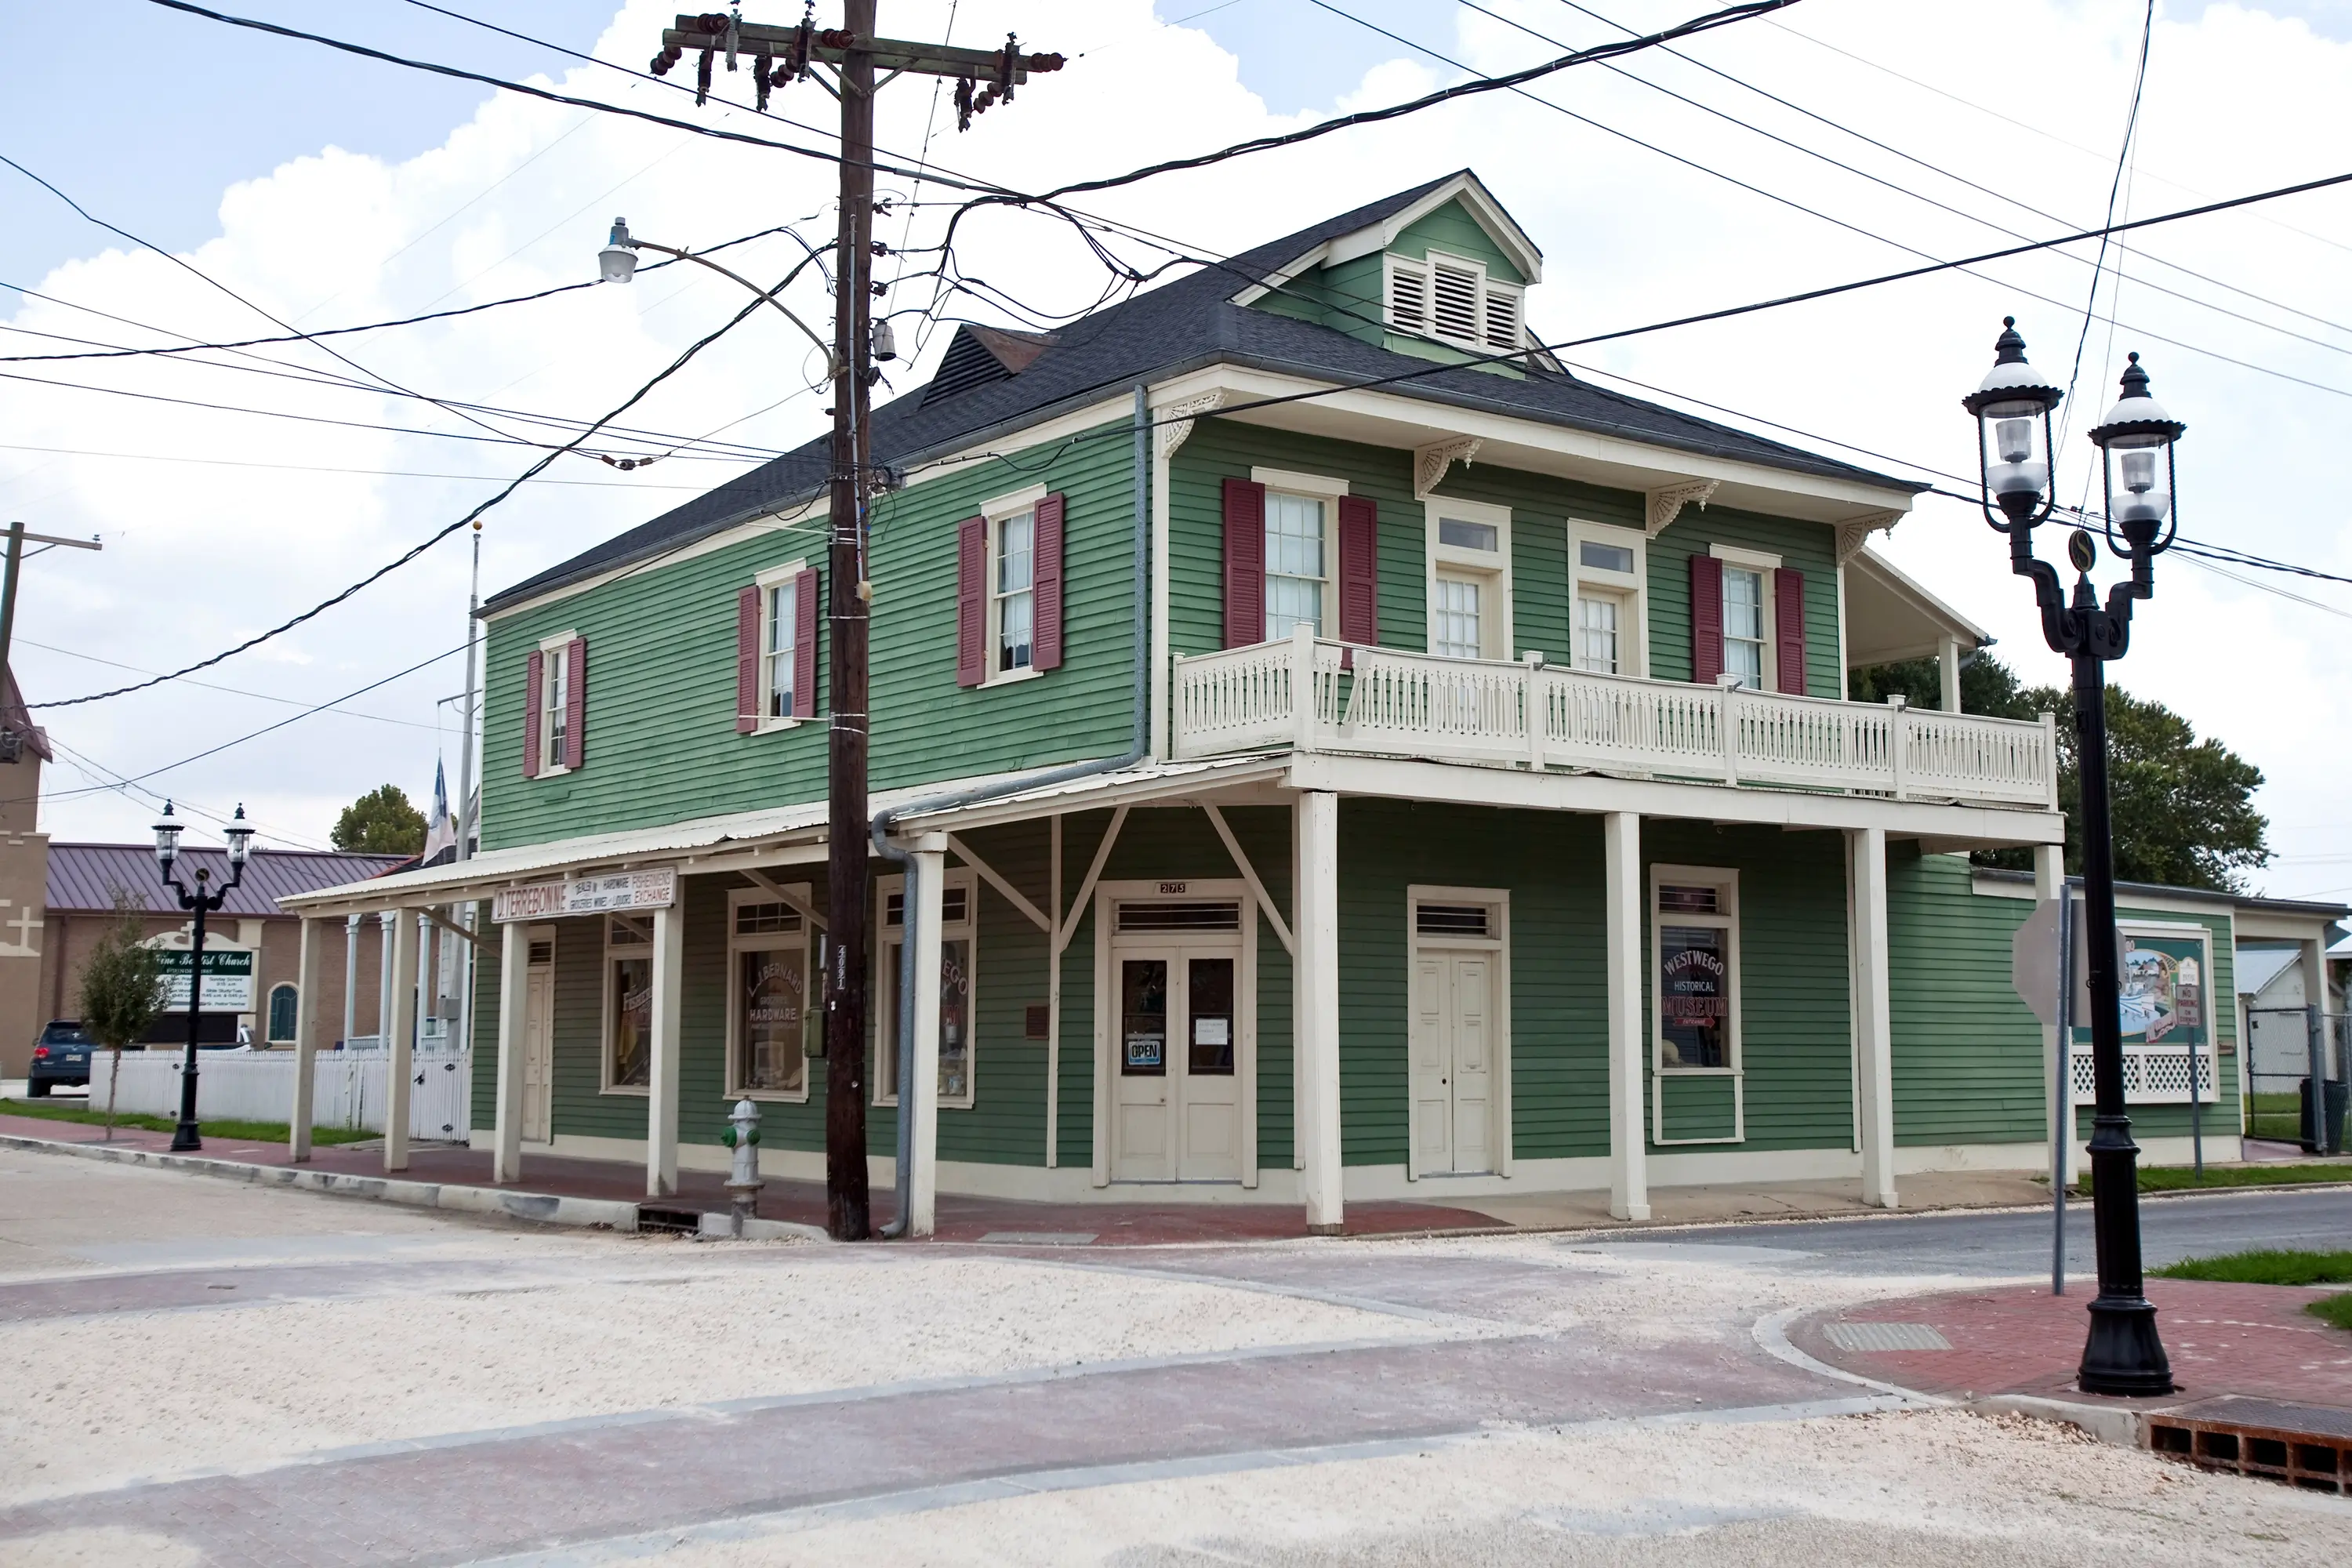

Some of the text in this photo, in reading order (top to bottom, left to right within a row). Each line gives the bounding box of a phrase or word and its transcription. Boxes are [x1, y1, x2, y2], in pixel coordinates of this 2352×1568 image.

[603, 877, 630, 890] HARDWARE
[1161, 884, 1185, 892] 275
[634, 887, 670, 904] EXCHANGE
[180, 953, 215, 965] Batist
[219, 954, 250, 966] Church
[1664, 950, 1724, 977] WESTWEGO
[1674, 981, 1715, 992] HISTORICAL
[2182, 989, 2191, 998] NO
[1661, 996, 1728, 1017] MUSEUM
[1131, 1044, 1157, 1058] OPEN
